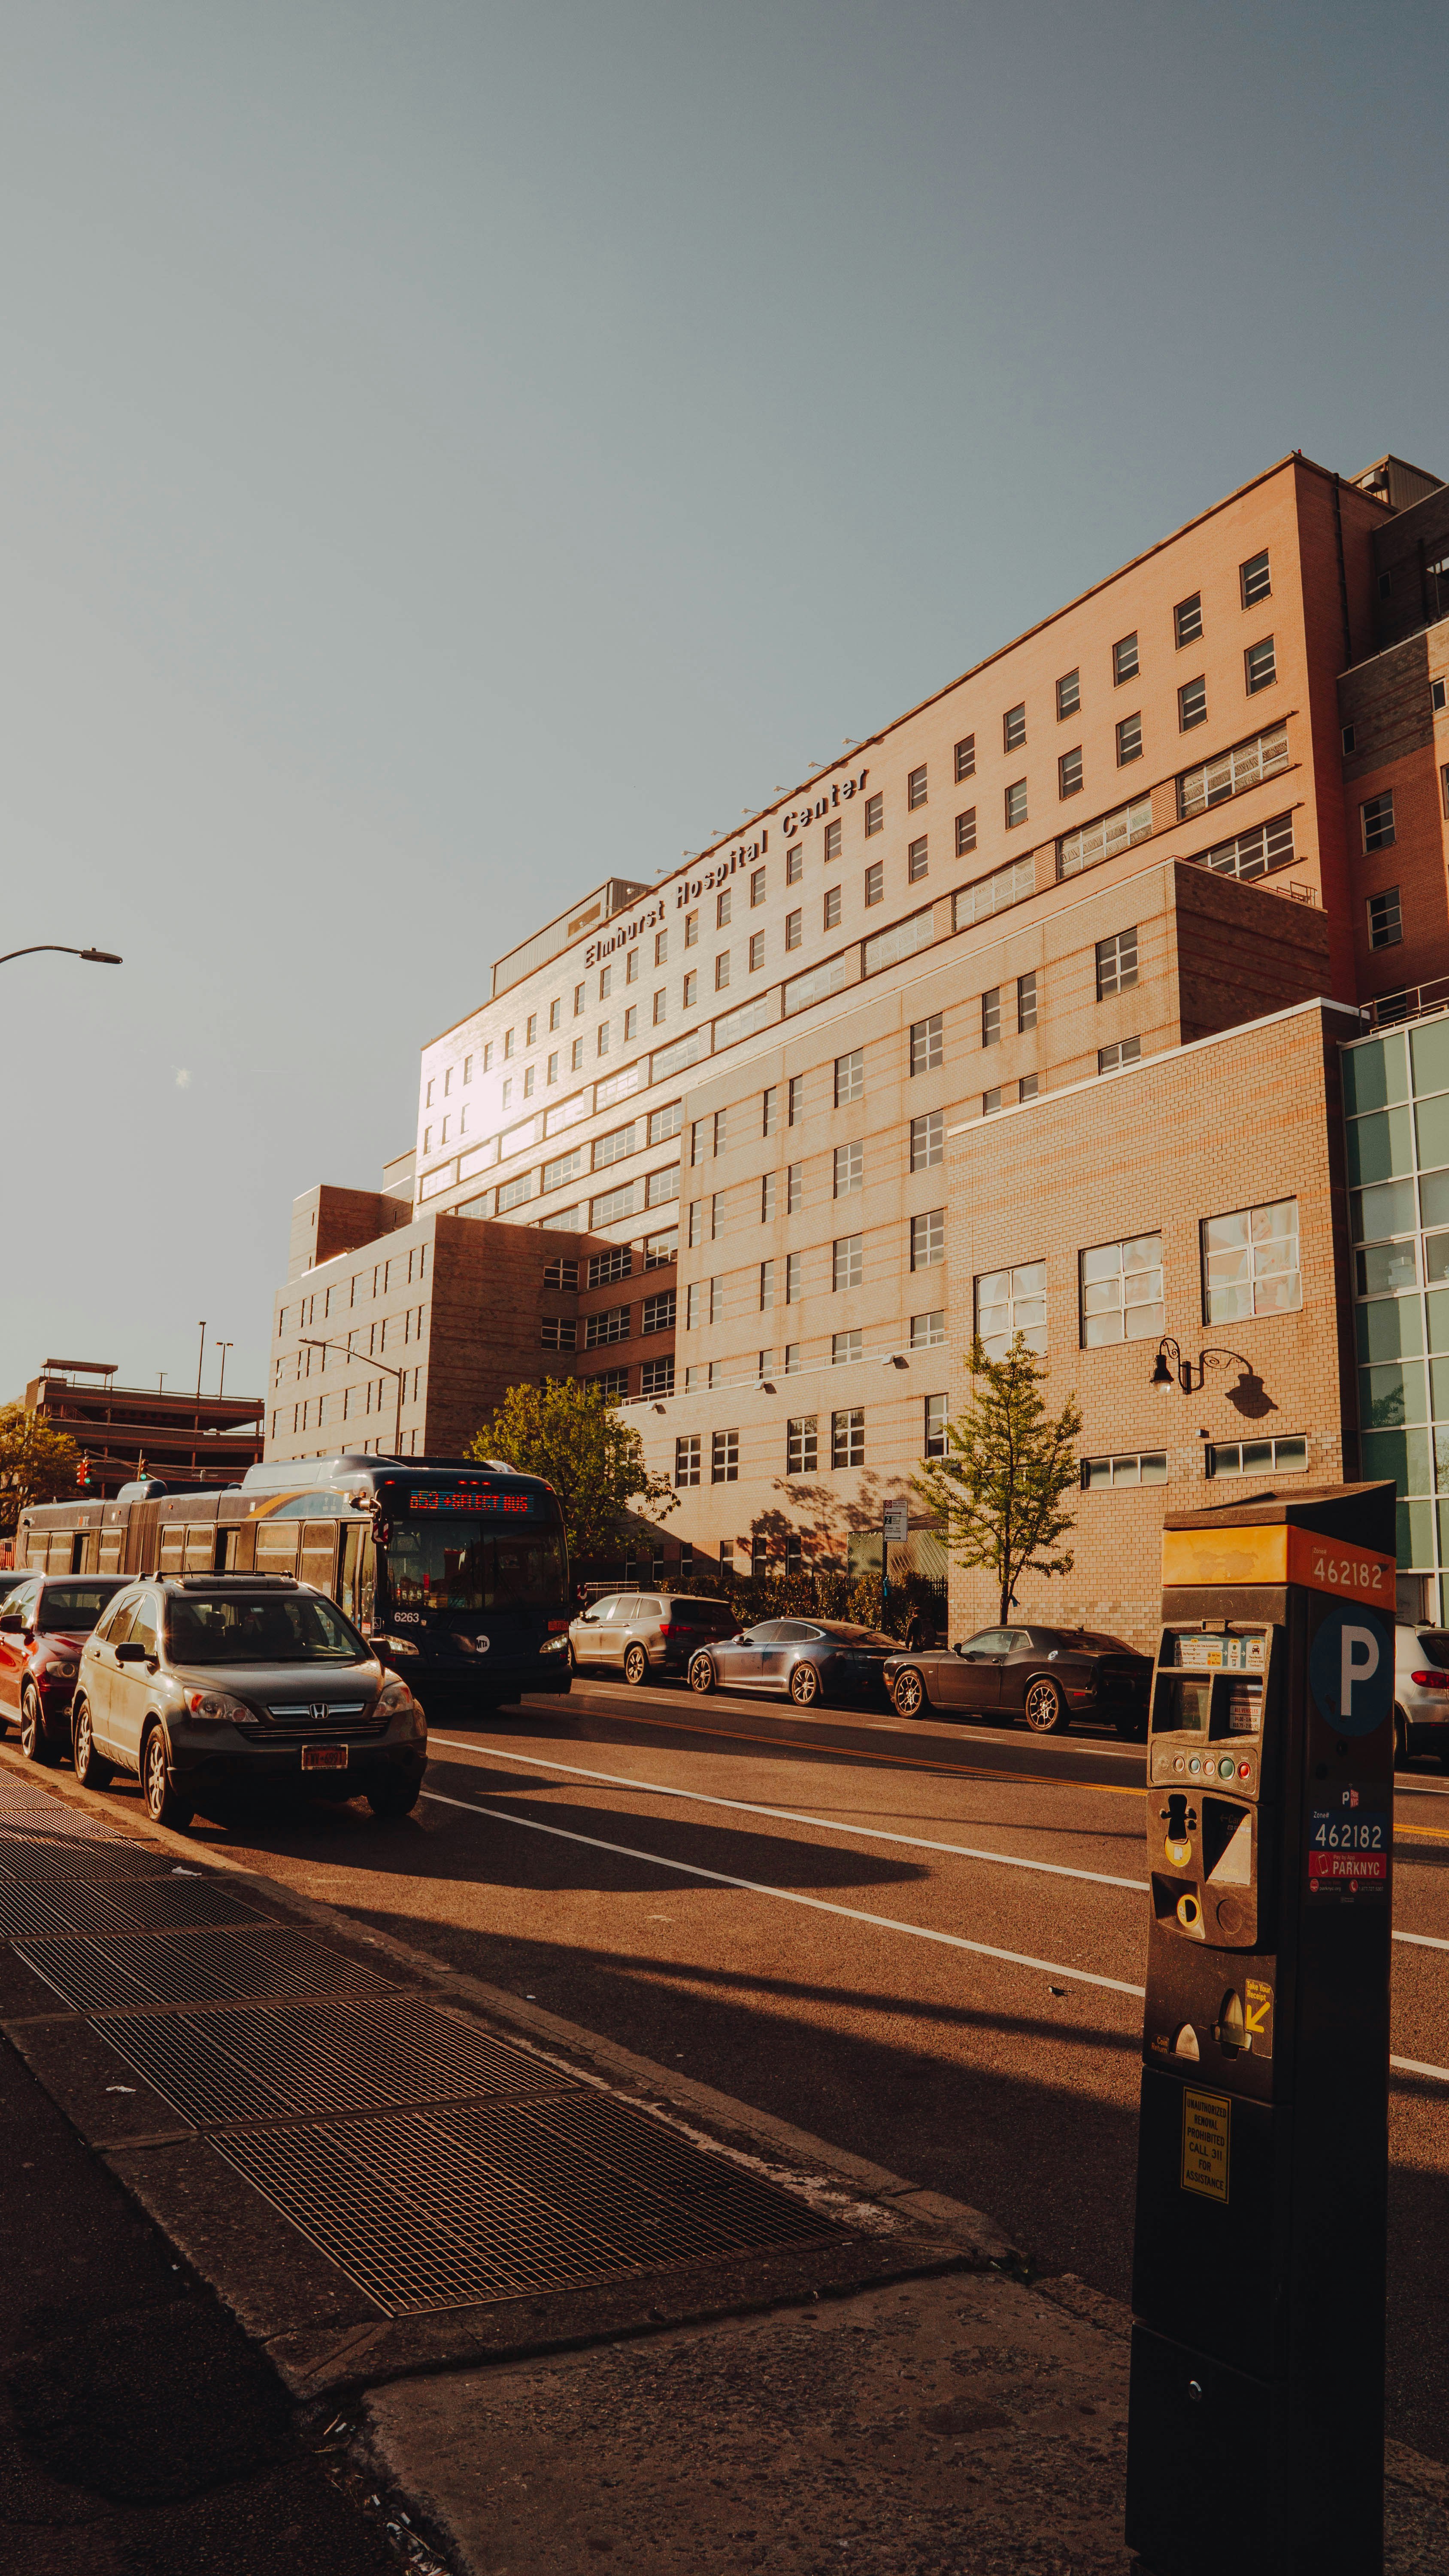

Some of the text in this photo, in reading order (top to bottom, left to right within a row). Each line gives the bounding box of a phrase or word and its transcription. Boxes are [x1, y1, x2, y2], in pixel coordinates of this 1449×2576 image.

[584, 769, 870, 968] Elmhurst Hospital Center
[1314, 1558, 1382, 1589] 462182
[394, 1612, 419, 1623] 6263
[476, 1639, 488, 1649] MTA
[1341, 1625, 1379, 1716] P
[1342, 1791, 1349, 1805] P
[1351, 1789, 1359, 1798] PARK
[1351, 1797, 1359, 1807] NYC
[1315, 1824, 1381, 1848] 462182
[1221, 1864, 1240, 1876] Coins
[1333, 1861, 1380, 1875] PARKNYC
[1246, 1981, 1271, 1994] Take Your
[1247, 1990, 1266, 2002] Receipt
[1151, 2042, 1167, 2054] Return
[1157, 2036, 1168, 2047] Coin
[1187, 2098, 1227, 2118] UNAUTHORIZED
[1194, 2114, 1218, 2130] REMOVAL
[1187, 2126, 1225, 2147] PROHIBITED
[1189, 2142, 1222, 2161] CALL 311
[1198, 2159, 1212, 2172] FOR
[1186, 2170, 1224, 2191] ASSISTANCE
